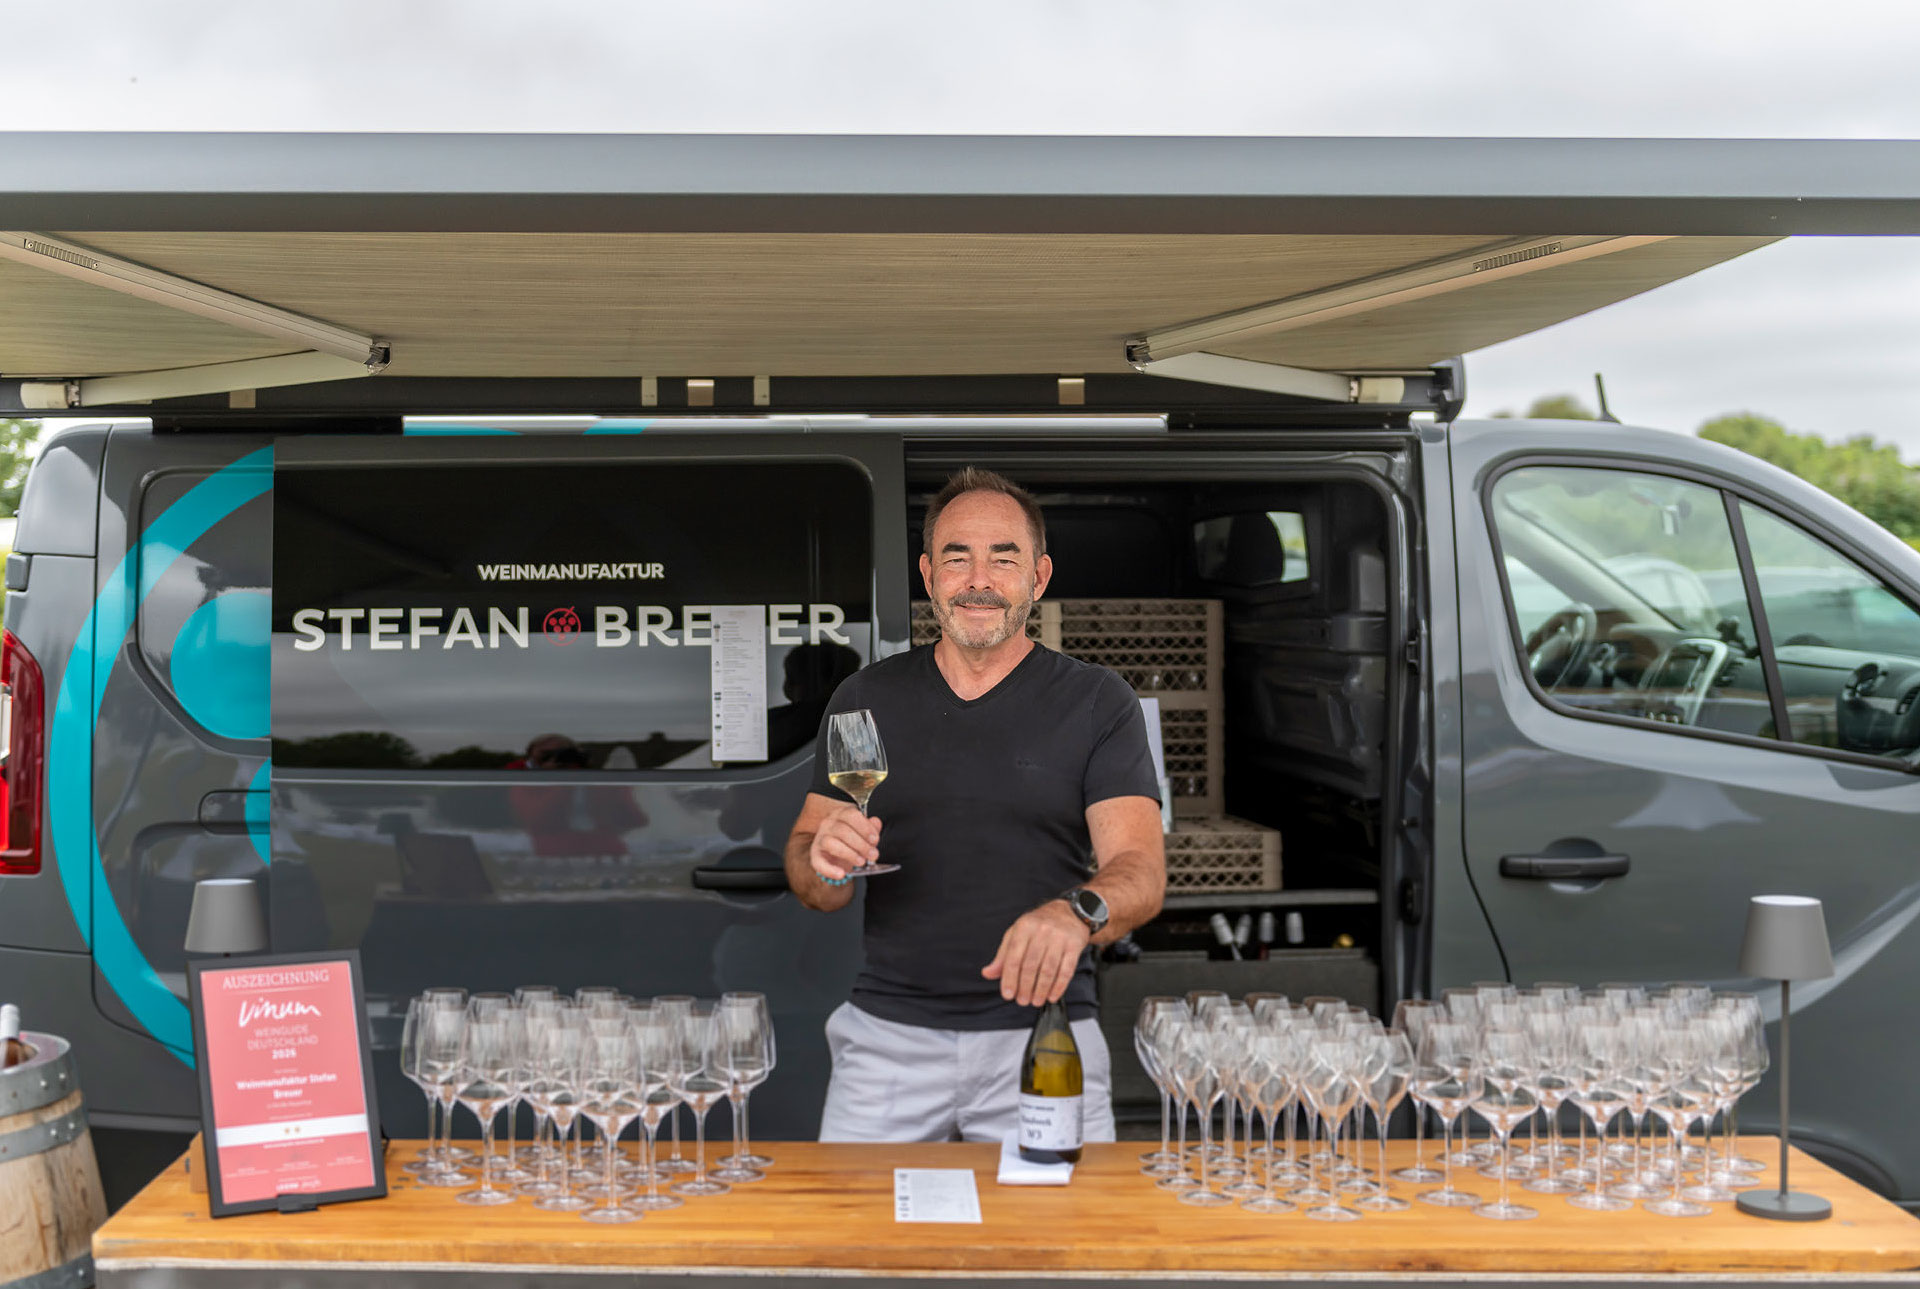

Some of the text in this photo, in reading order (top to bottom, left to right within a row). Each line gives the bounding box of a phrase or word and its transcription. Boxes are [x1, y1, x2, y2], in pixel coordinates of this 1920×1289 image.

[477, 563, 664, 581] WEINMANUFAKTUR
[292, 604, 851, 652] STEFAN BREER
[223, 969, 330, 990] AUSZEICHNUNG
[254, 1024, 309, 1037] WEINGUIDE
[247, 1035, 318, 1051] DEUTSCHLAND
[236, 1073, 337, 1090] Weinmanufaktur Stefan
[273, 1089, 303, 1099] Breuer
